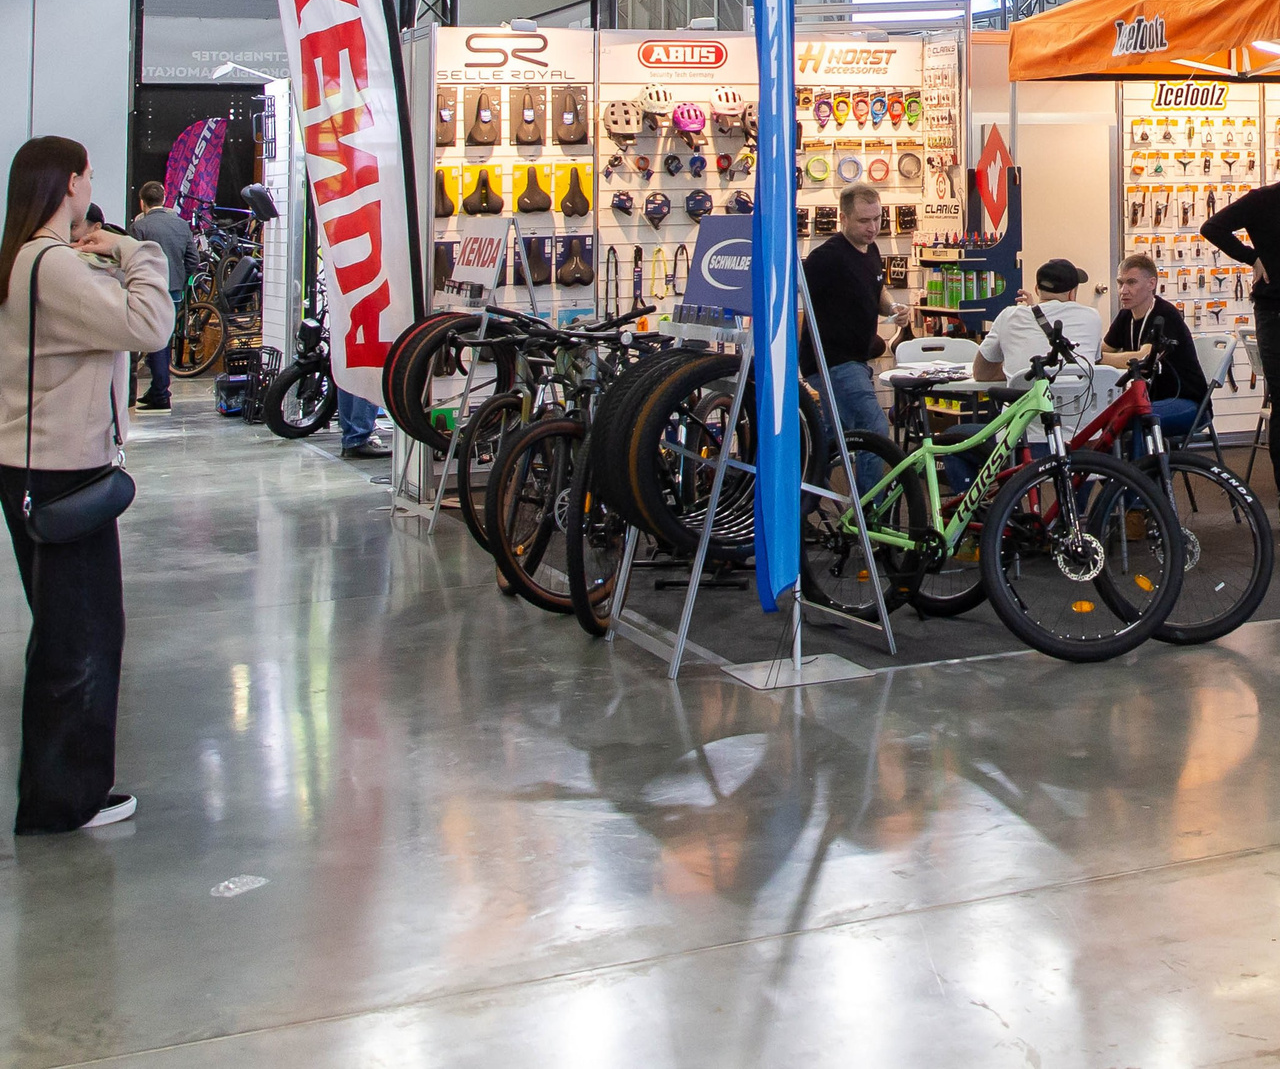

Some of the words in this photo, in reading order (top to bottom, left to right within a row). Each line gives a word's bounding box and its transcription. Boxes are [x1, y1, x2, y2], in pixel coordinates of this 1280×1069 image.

[1115, 15, 1168, 53] IceToolz
[649, 47, 716, 62] ABUS
[827, 49, 897, 65] HORST
[437, 70, 503, 79] SELLE
[511, 70, 575, 79] ROYAL
[824, 66, 888, 75] accessories
[1155, 83, 1226, 107] IceToolz
[925, 204, 960, 214] CLARKS
[457, 236, 502, 268] KENDA
[709, 255, 752, 271] SCHWALBE
[957, 433, 1014, 523] HORST
[1210, 466, 1253, 503] KENDA
